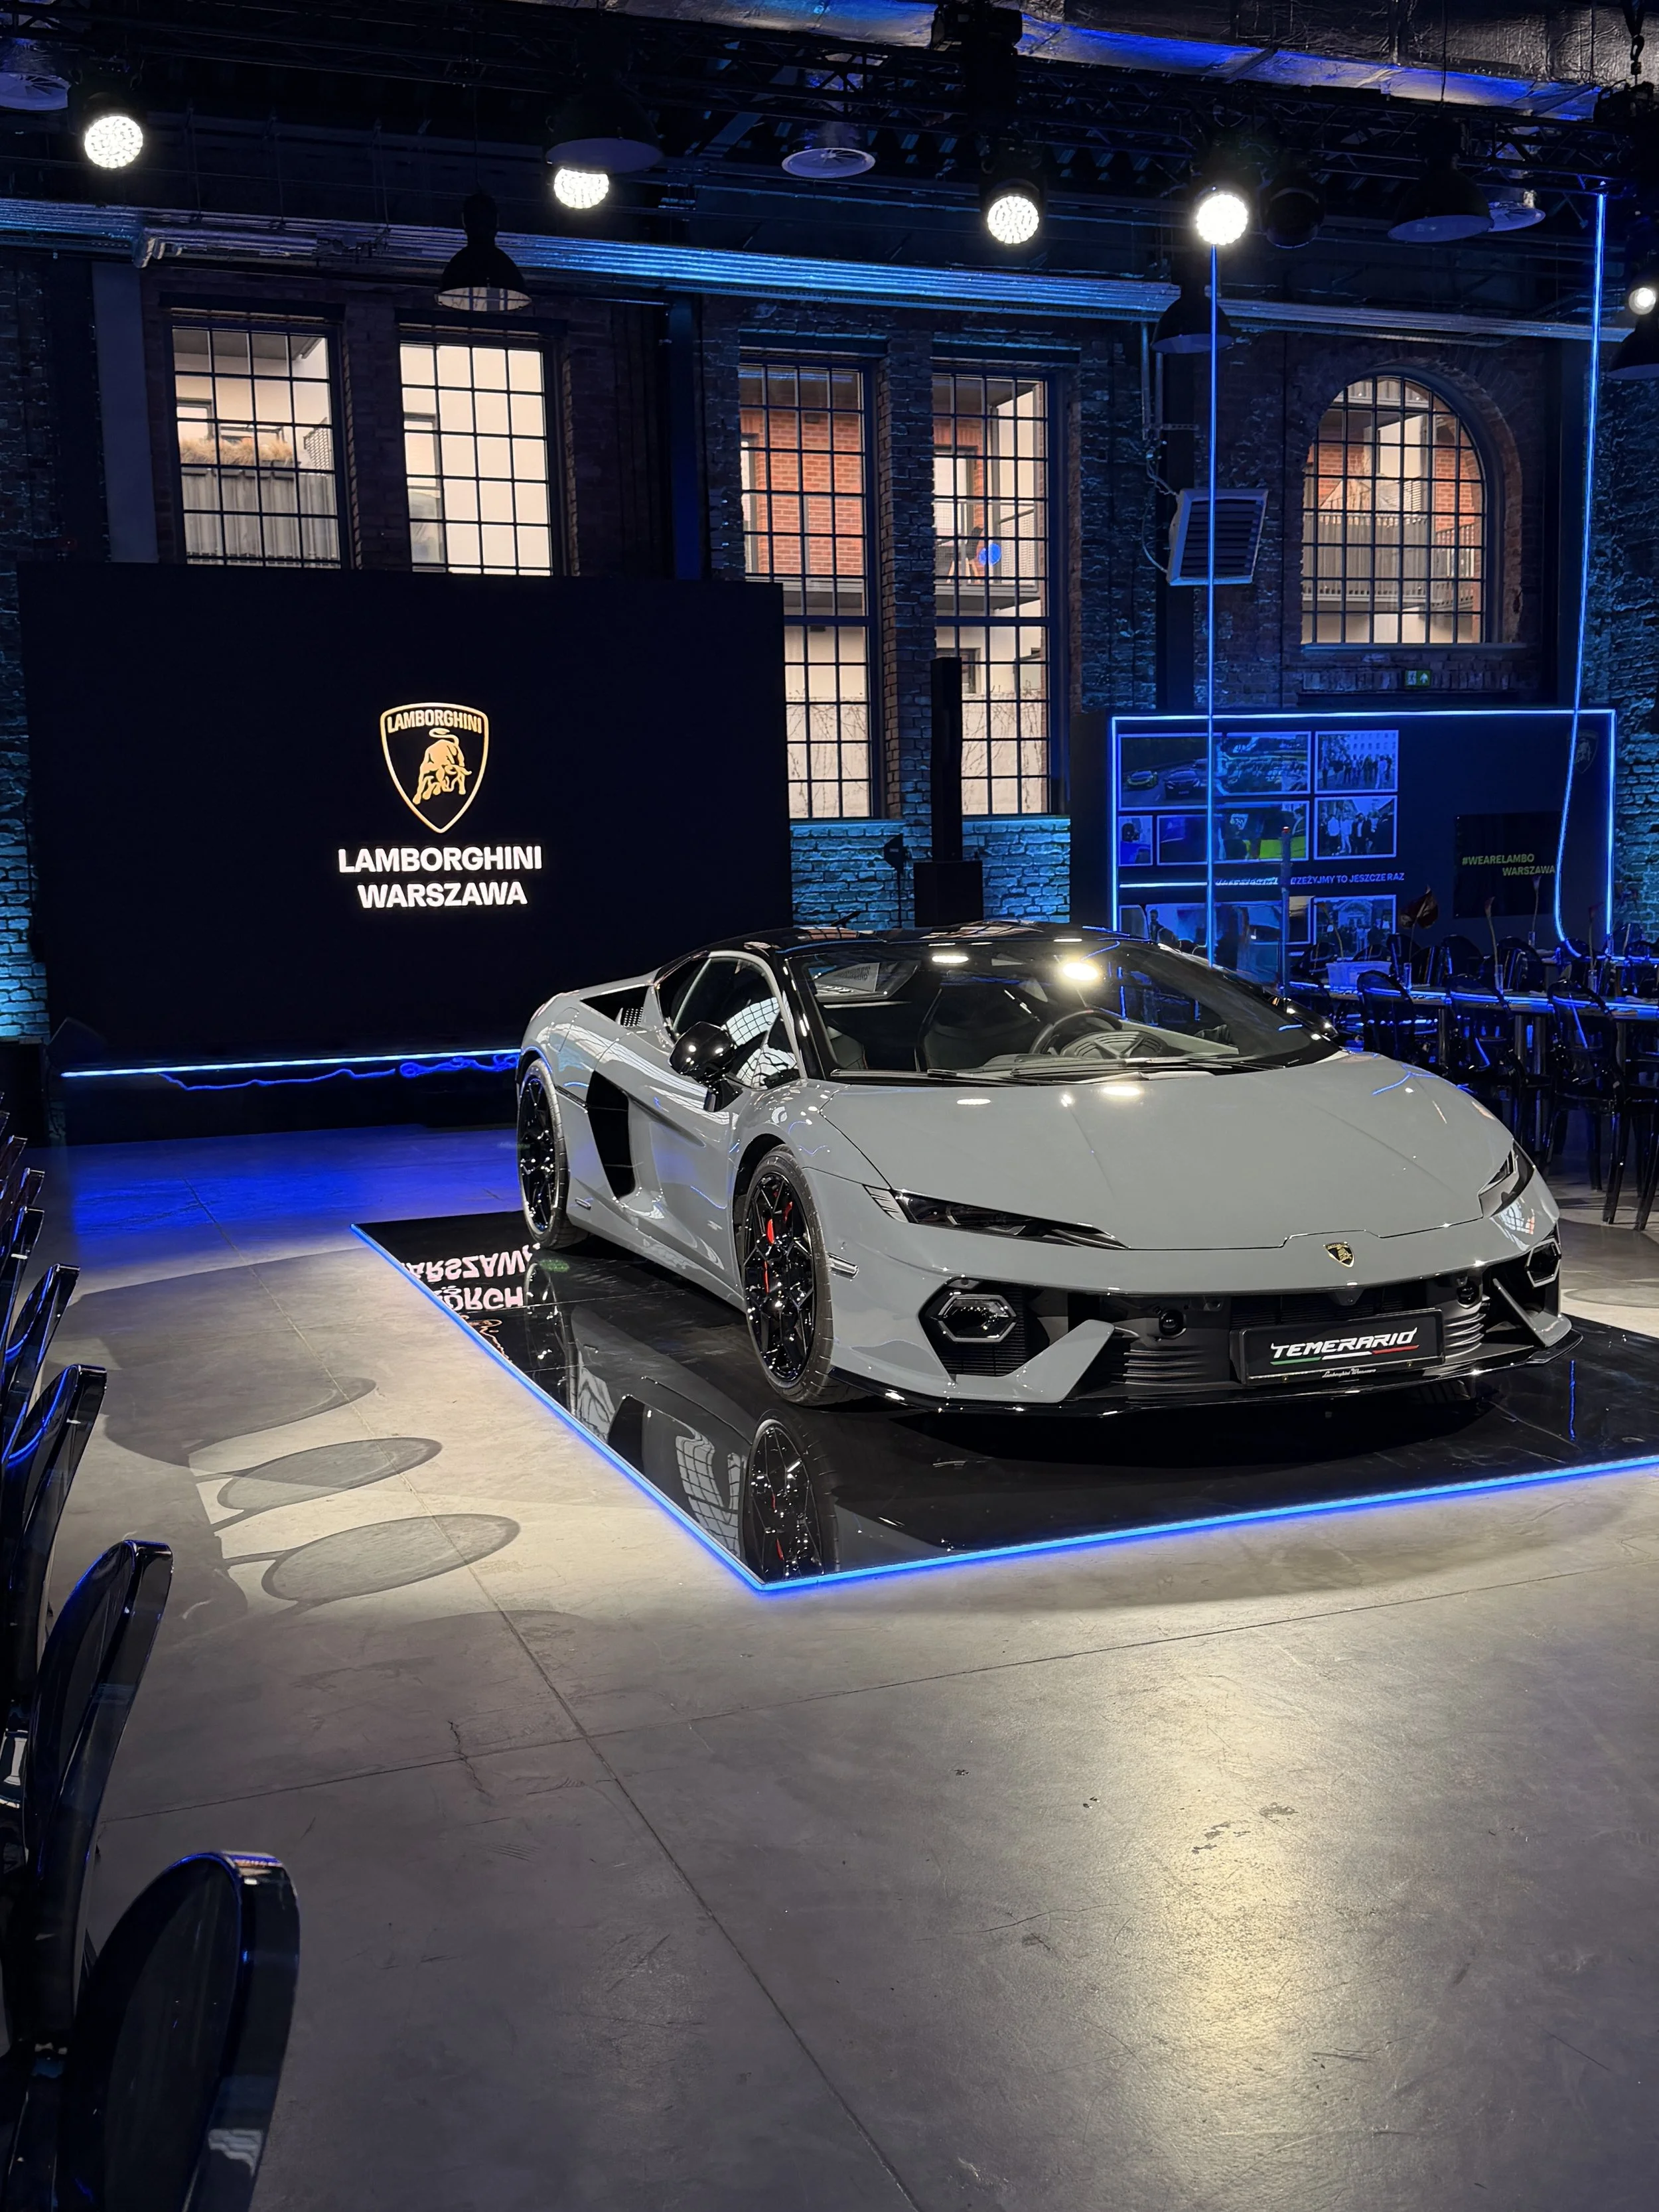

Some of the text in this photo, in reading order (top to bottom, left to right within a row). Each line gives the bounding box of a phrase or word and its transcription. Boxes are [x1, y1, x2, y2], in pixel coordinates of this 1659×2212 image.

[388, 709, 482, 734] LAMBORGHINI
[338, 846, 542, 873] LAMBORGHINI
[1462, 853, 1535, 865] #WEARELAMBO
[1502, 865, 1555, 876] WARSZAWA
[1336, 874, 1348, 883] TO
[1349, 873, 1386, 883] JESZCZE
[1386, 872, 1405, 881] RAZ
[357, 881, 528, 909] WARSZAWA
[1270, 1327, 1418, 1359] TEMERARIO
